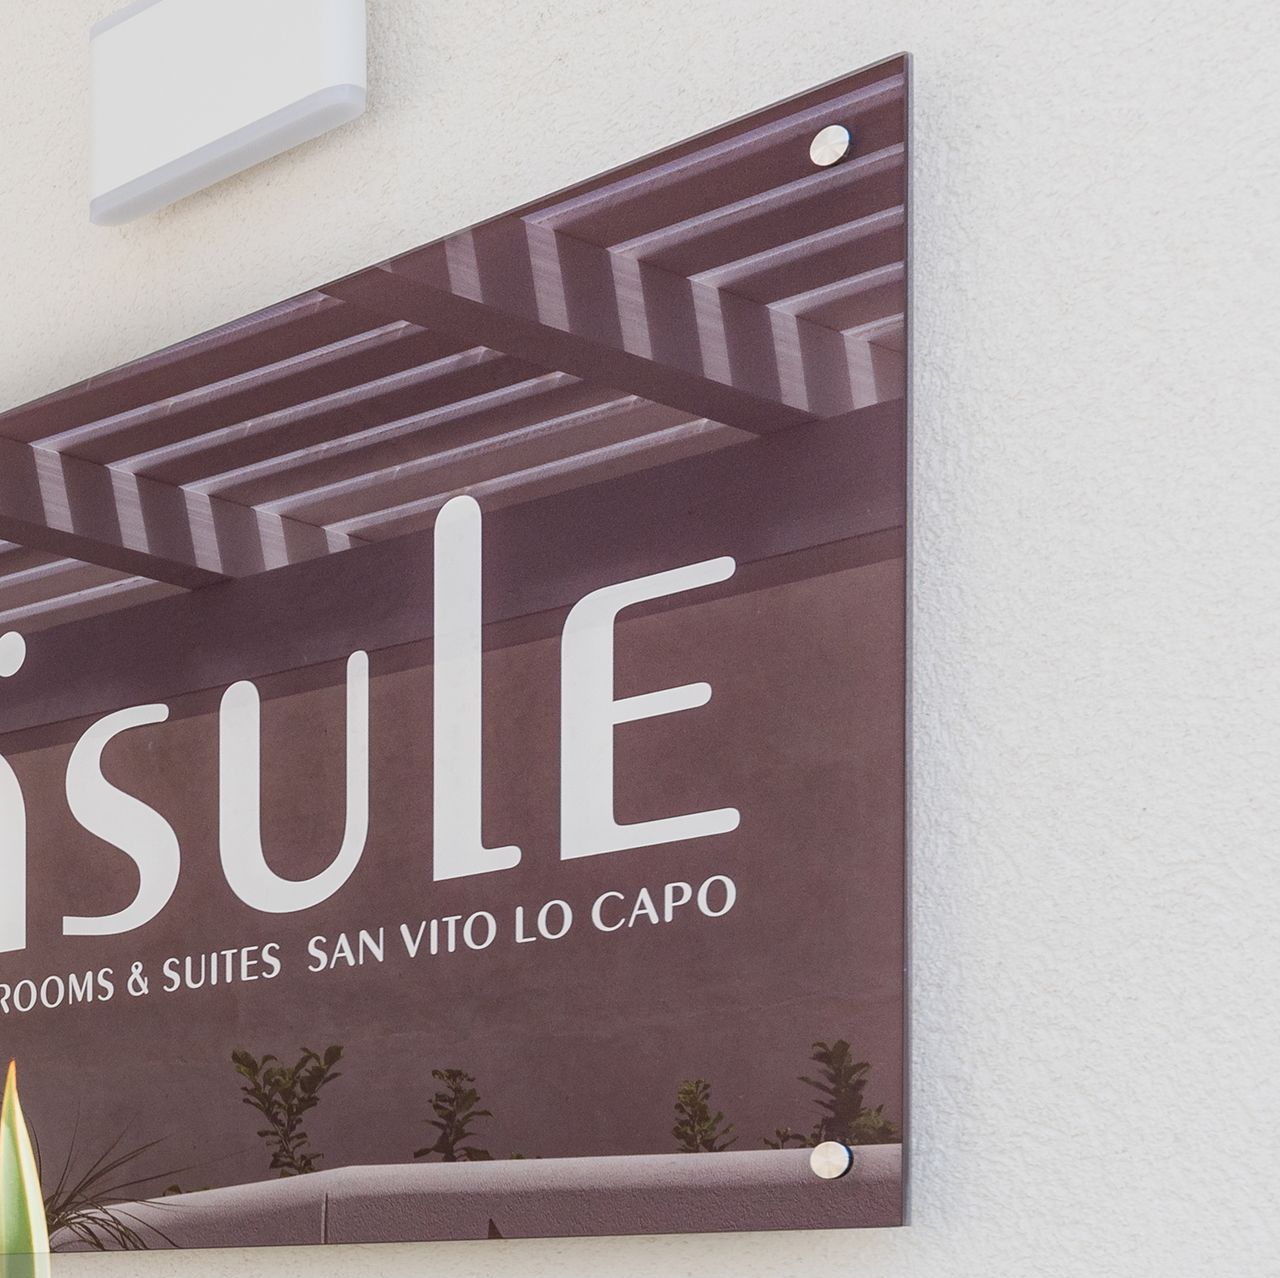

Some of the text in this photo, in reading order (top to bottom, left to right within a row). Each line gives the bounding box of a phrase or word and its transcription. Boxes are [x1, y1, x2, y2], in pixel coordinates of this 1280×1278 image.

[126, 961, 150, 998] &
[162, 942, 282, 993] SUITES
[307, 927, 385, 973] SAN
[399, 911, 498, 959] VITO
[514, 899, 574, 945] LO
[590, 875, 738, 933] CAPO
